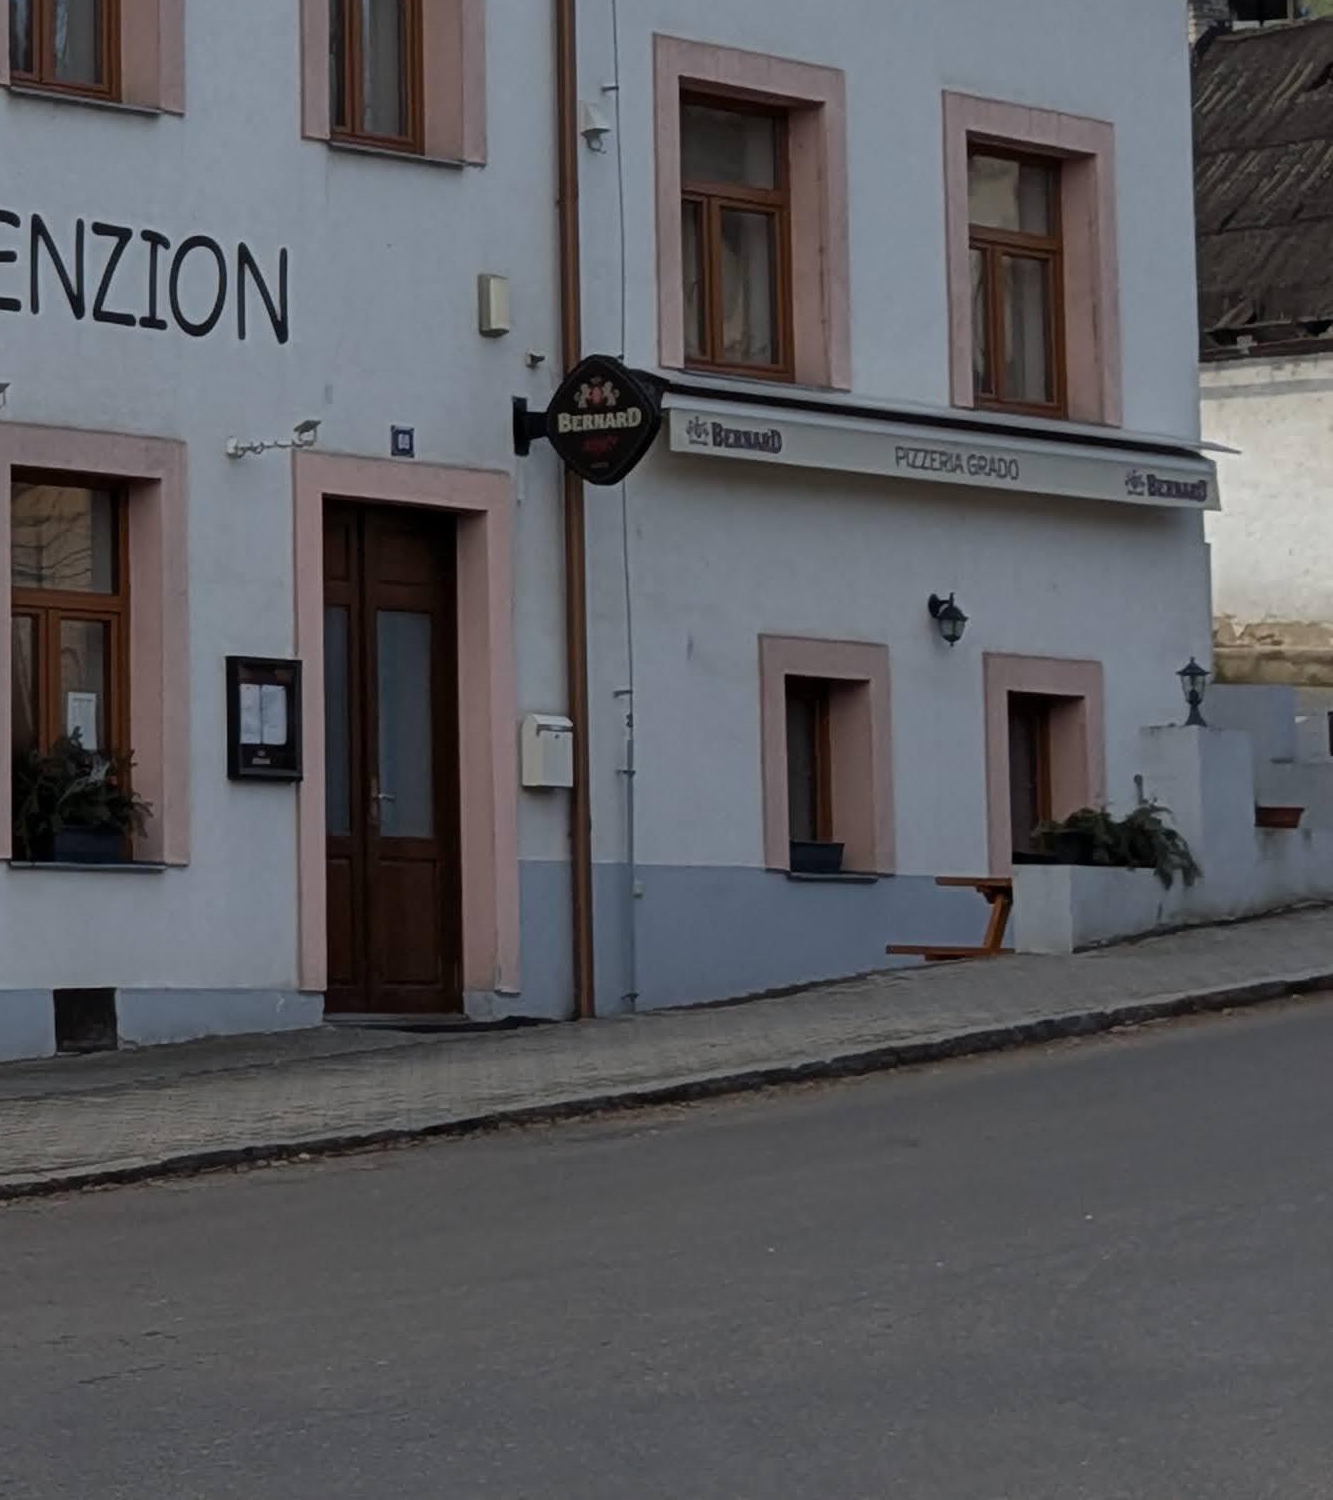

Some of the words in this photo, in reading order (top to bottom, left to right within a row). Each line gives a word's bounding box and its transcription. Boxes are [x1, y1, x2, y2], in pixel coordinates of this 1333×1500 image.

[557, 406, 642, 434] BERNARD
[711, 421, 783, 454] BERNARD
[894, 445, 964, 476] PIZZERIA
[967, 453, 1020, 481] GRADO
